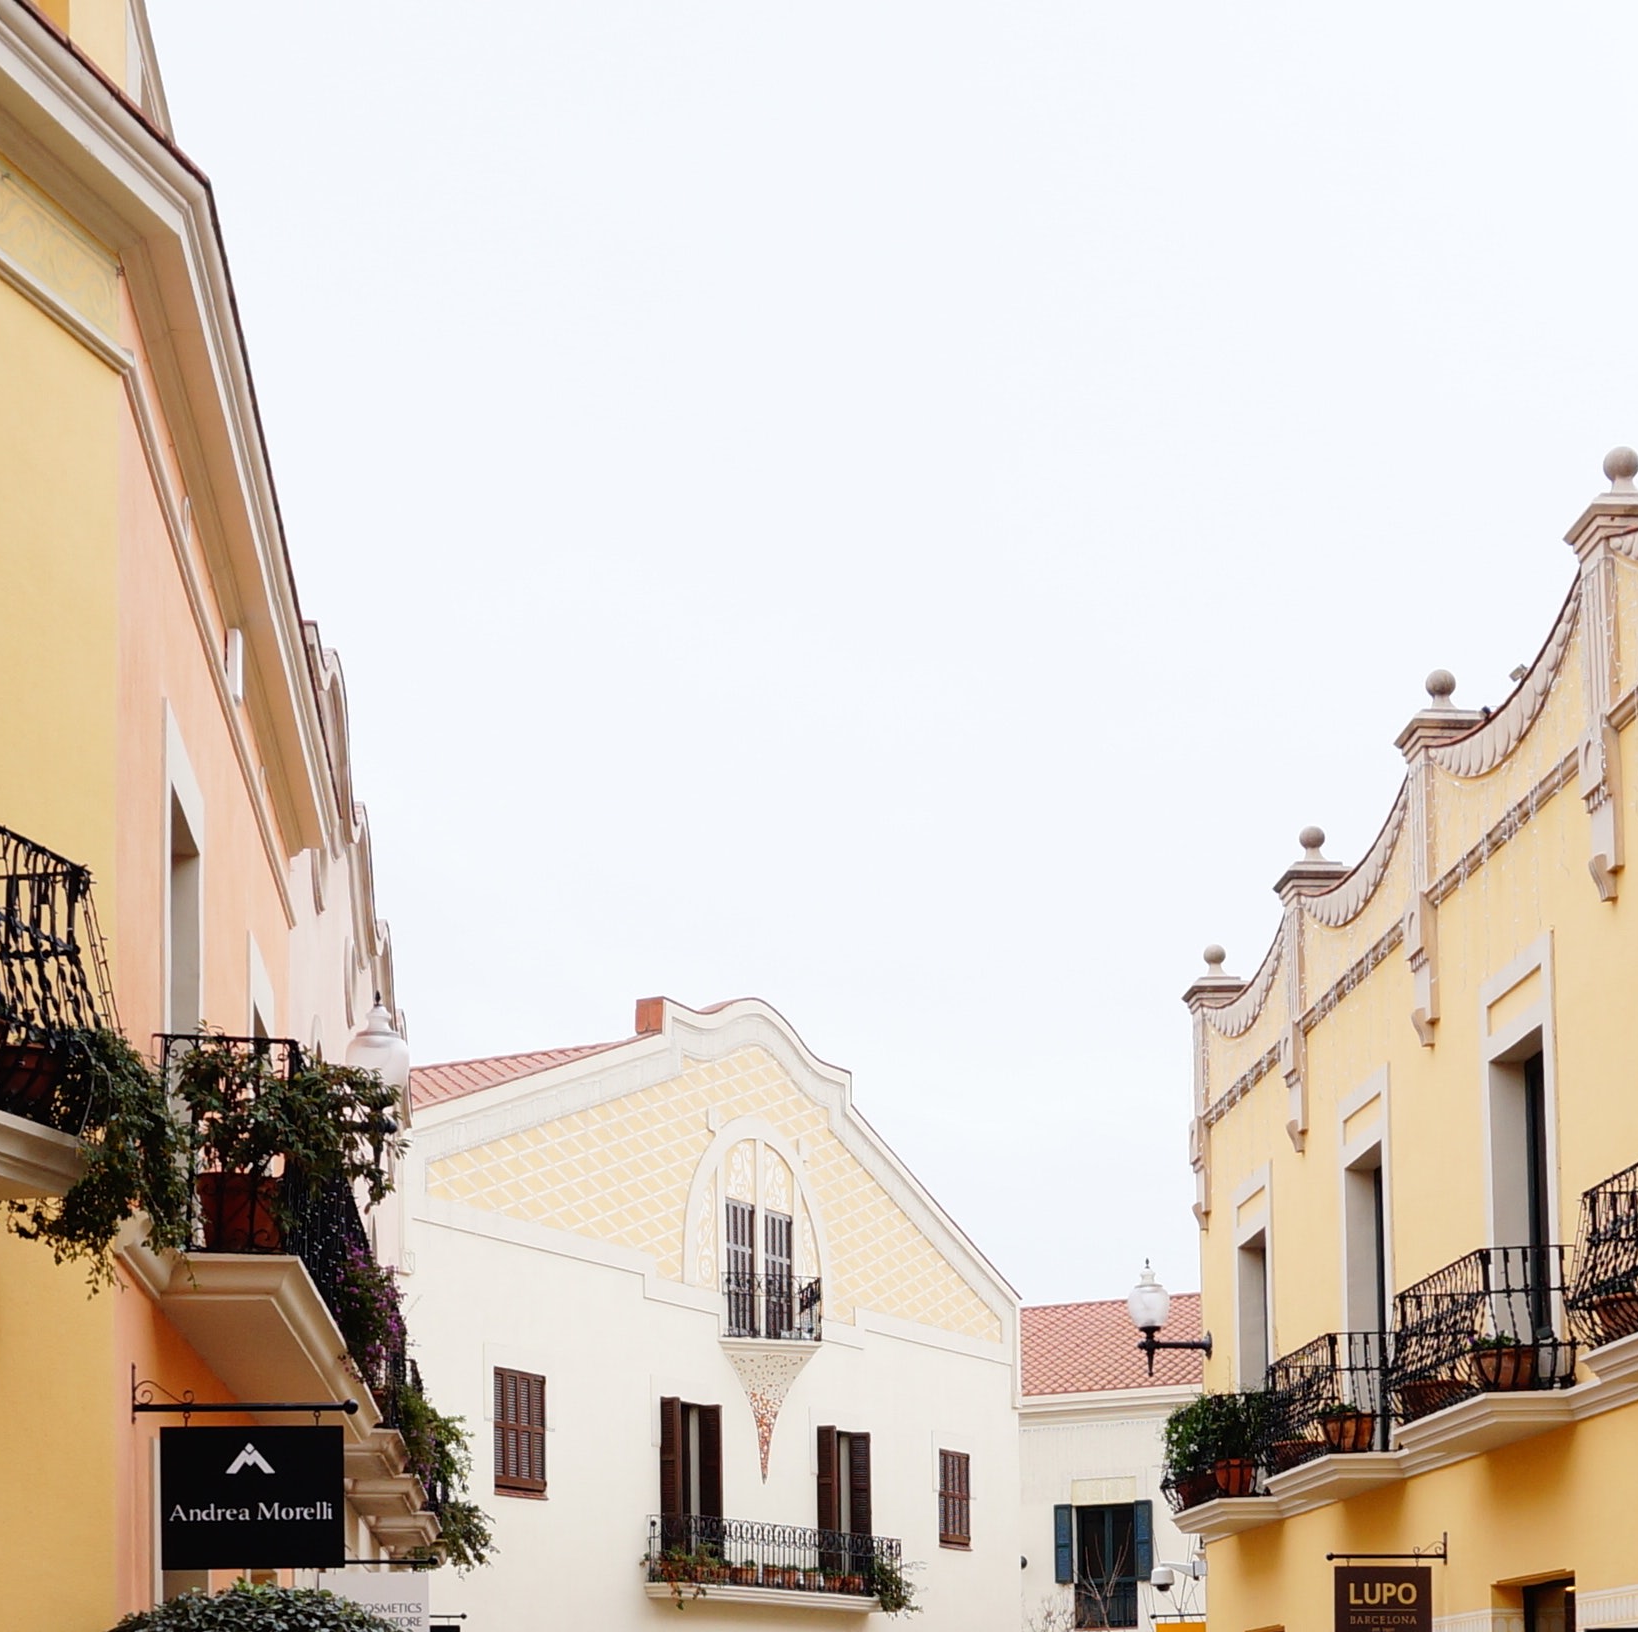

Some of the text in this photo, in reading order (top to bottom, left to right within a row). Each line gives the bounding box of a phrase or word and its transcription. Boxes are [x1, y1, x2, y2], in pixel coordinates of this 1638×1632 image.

[169, 1500, 334, 1522] Andrea Morelli
[1349, 1582, 1418, 1605] LUPO
[364, 1602, 423, 1615] OSMETICS
[1349, 1615, 1418, 1626] BARCELONA
